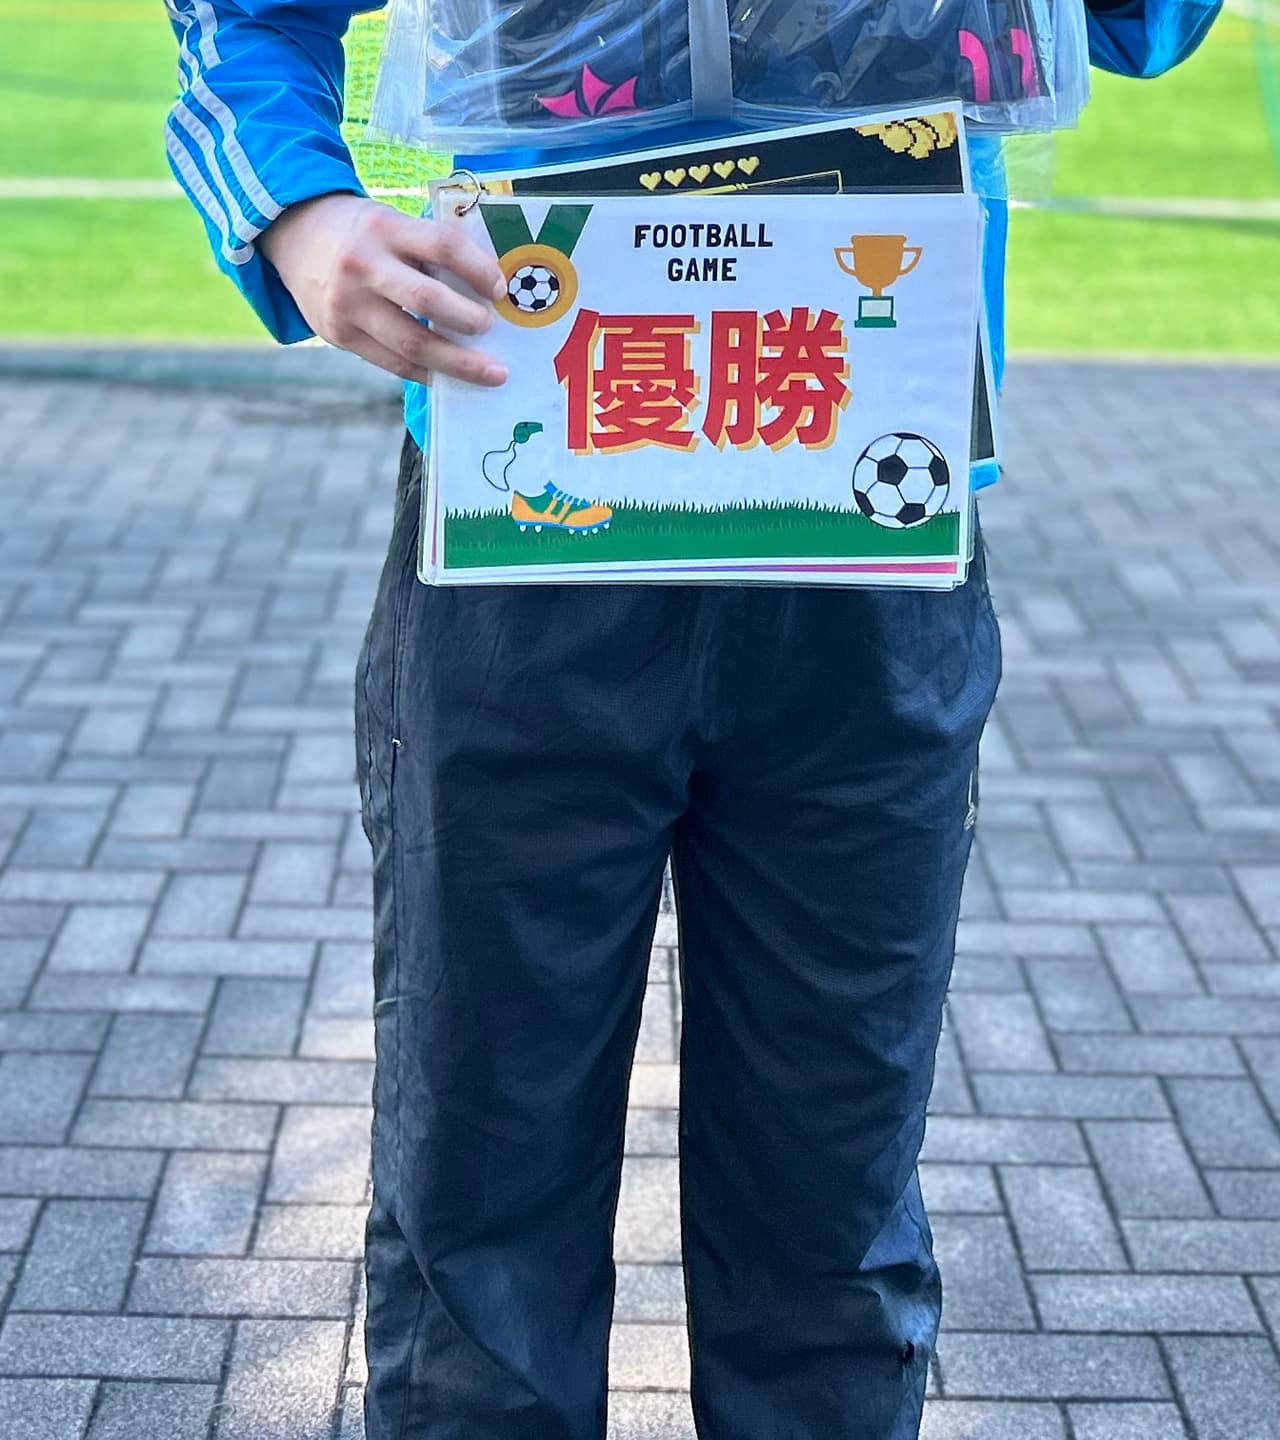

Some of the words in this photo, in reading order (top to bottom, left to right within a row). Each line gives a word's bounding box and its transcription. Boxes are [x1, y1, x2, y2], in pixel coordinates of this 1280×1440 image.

[634, 223, 773, 249] FOOTBALL
[667, 257, 738, 283] GAME
[553, 307, 854, 457] 優勝
